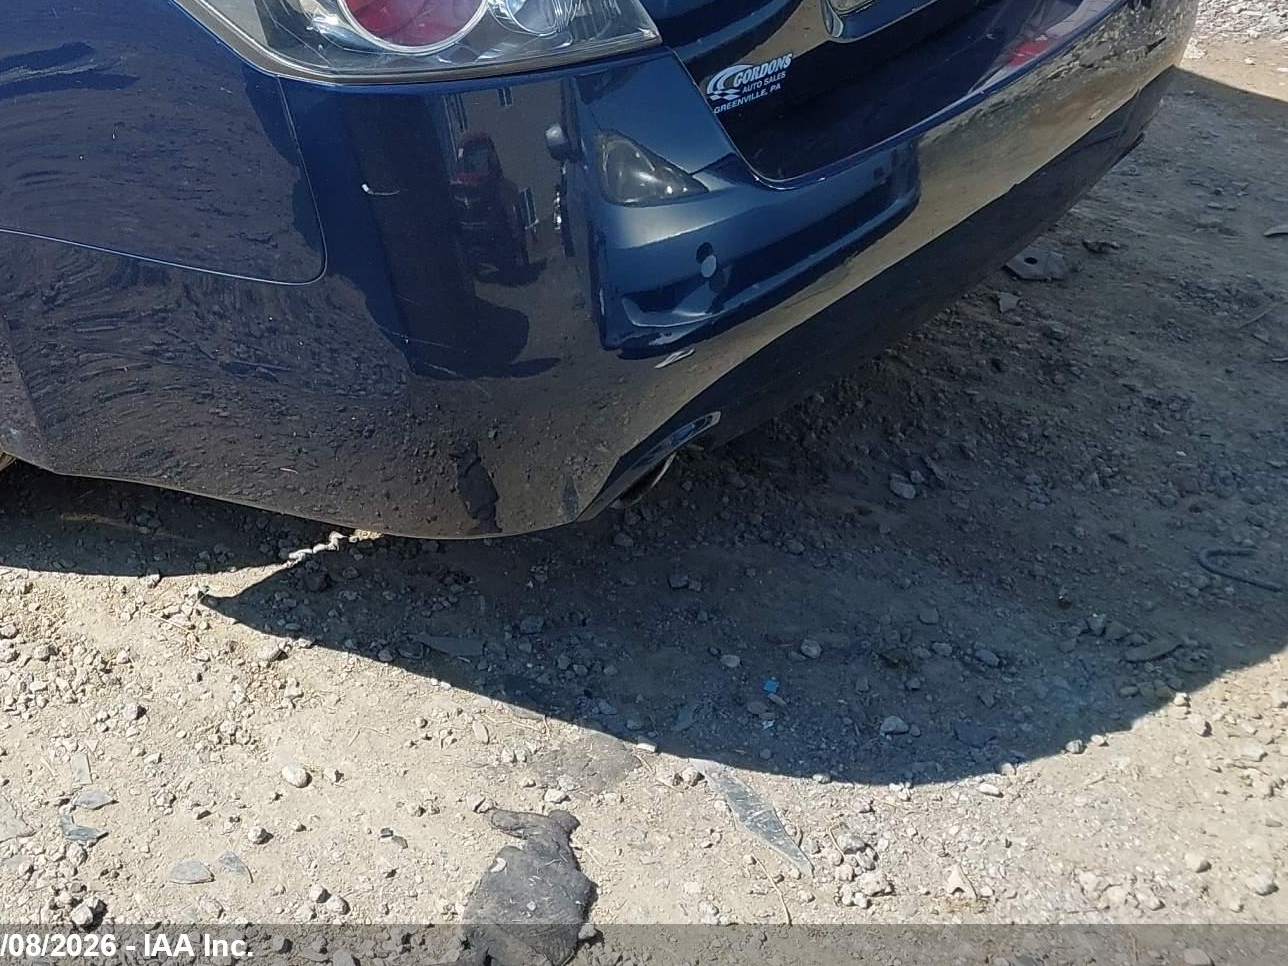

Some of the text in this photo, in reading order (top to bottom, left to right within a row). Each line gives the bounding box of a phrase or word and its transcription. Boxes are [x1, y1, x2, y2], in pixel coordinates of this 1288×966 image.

[733, 53, 793, 88] GORDONS
[742, 71, 787, 94] AUTO SALES
[770, 82, 782, 93] PA
